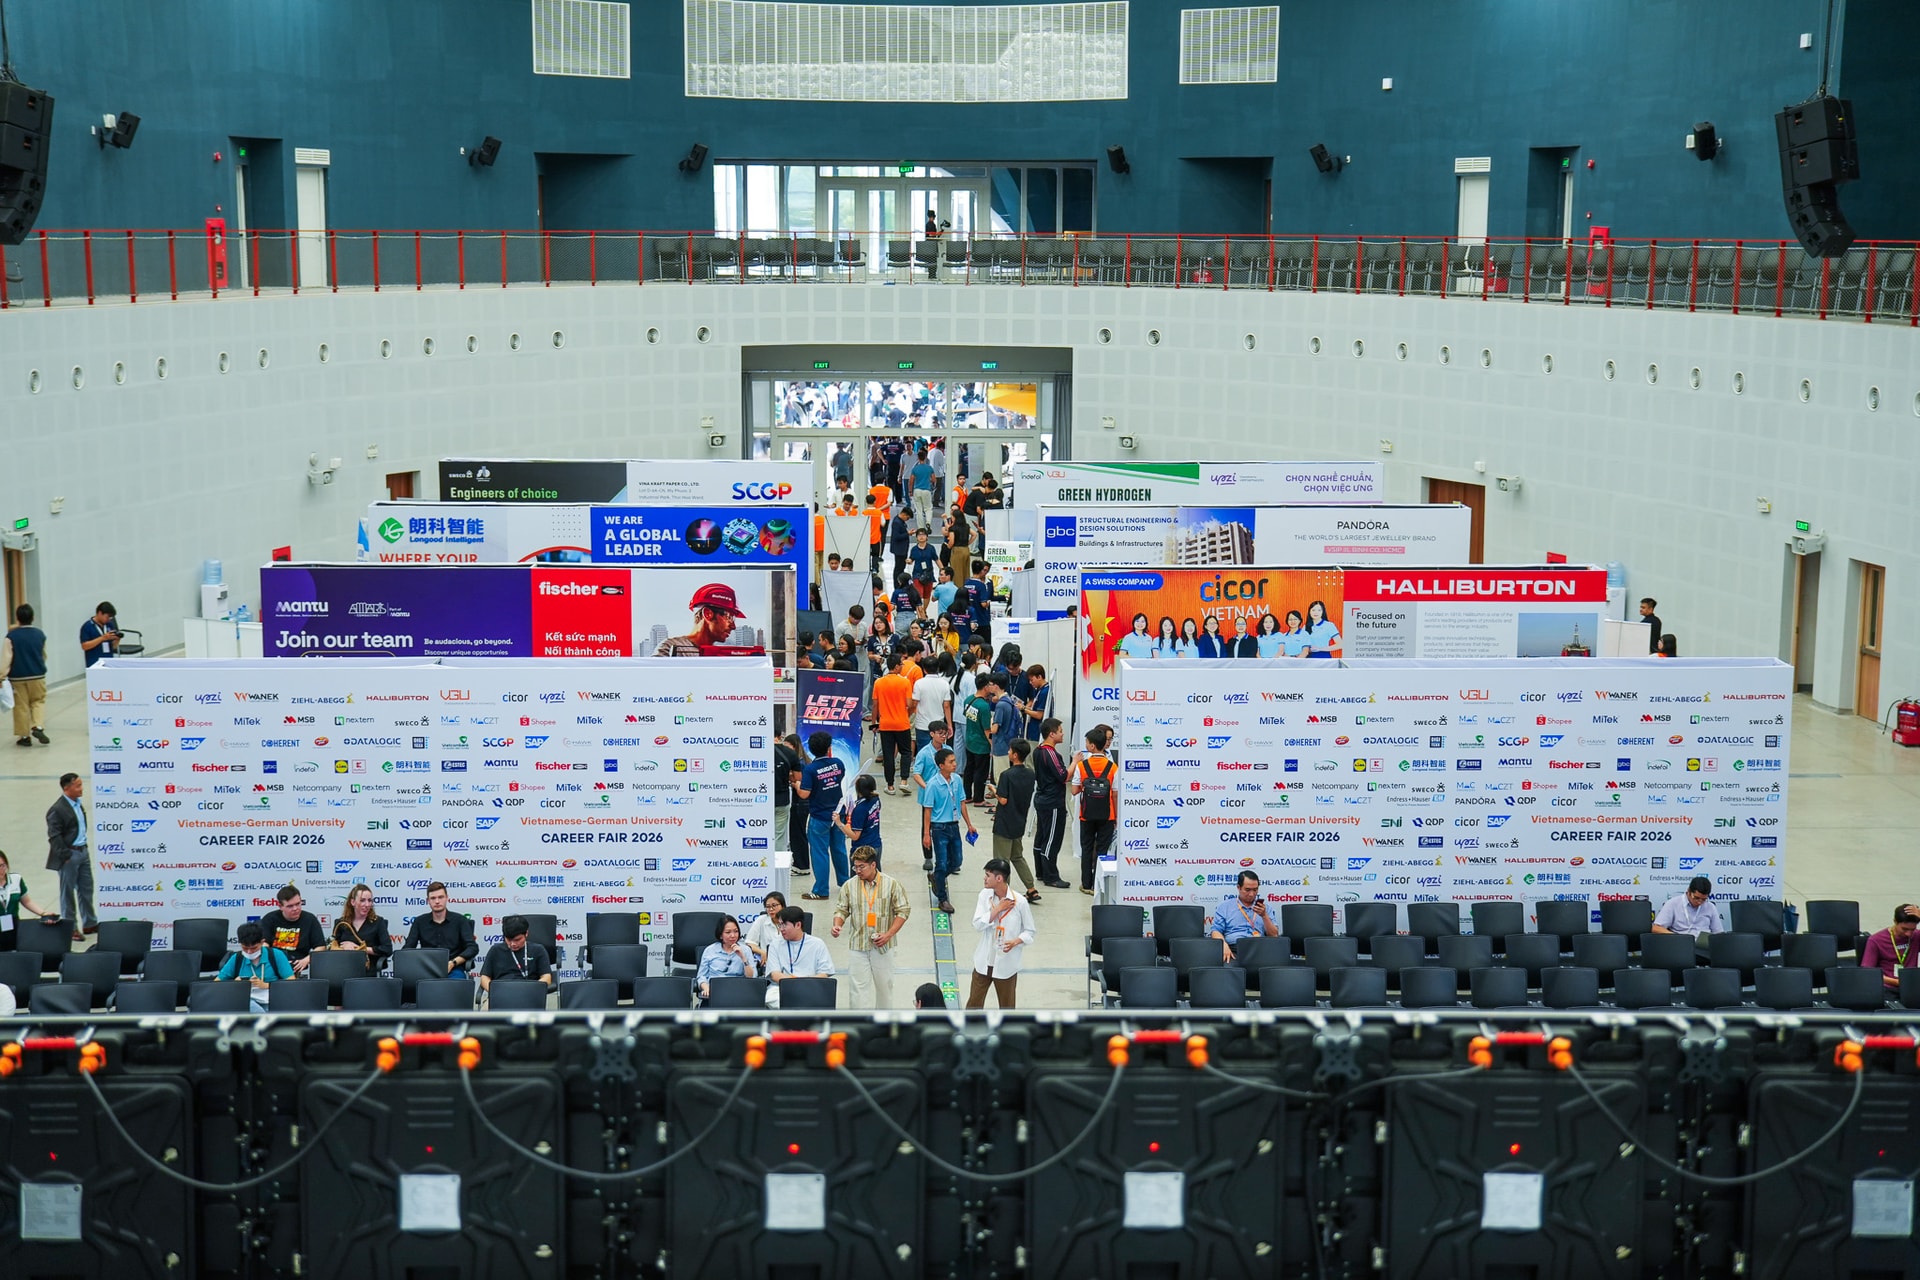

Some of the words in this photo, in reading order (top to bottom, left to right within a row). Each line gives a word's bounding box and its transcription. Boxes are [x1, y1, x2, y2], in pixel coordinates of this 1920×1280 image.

[1286, 475, 1311, 483] CHỌN
[1313, 471, 1337, 481] NGHỀ
[1340, 471, 1373, 482] CHUẨN,
[732, 483, 792, 500] SCGP
[1304, 485, 1329, 494] CHỌN
[1331, 483, 1351, 493] VIỆC
[449, 487, 505, 502] Engineers
[508, 488, 518, 498] of
[521, 488, 557, 498] choice
[1059, 489, 1091, 501] GREEN
[1096, 489, 1151, 501] HYDROGEN
[604, 516, 624, 525] WE
[623, 516, 643, 525] ARE
[409, 517, 484, 535] 朗科智能
[604, 529, 616, 540] A
[620, 529, 681, 541] GLOBAL
[1046, 526, 1075, 538] gbc
[410, 536, 443, 544] Longood
[445, 536, 484, 544] Intelligent
[606, 544, 662, 555] LEADER
[379, 553, 431, 564] WHERE
[987, 555, 1016, 563] HYDROGEN
[1045, 562, 1077, 570] GROW
[1084, 577, 1092, 585] A
[1092, 577, 1116, 586] SWISS
[1117, 577, 1155, 586] COMPANY
[539, 581, 599, 595] fischer
[1200, 574, 1269, 603] cicor
[1377, 579, 1576, 595] HALLIBURTON
[1357, 612, 1392, 620] Focused
[276, 631, 319, 648] Join
[324, 635, 358, 648] our
[361, 632, 413, 647] team
[484, 638, 513, 646] beyond.
[546, 632, 563, 641] Kết
[566, 632, 585, 641] sức
[588, 633, 616, 643] mạnh
[450, 649, 471, 657] unique
[545, 646, 561, 655] Nối
[564, 647, 592, 657] thành
[596, 647, 621, 658] công
[157, 693, 183, 703] cicor
[248, 692, 278, 702] WANEK
[291, 696, 344, 704] ZIEHL-ABEGG
[1607, 691, 1637, 700] WANEK
[805, 694, 859, 709] LET'S
[803, 706, 854, 720] ROCK
[185, 719, 212, 728] Shopee
[234, 717, 260, 725] MiTek
[298, 716, 315, 724] MSB
[346, 716, 374, 724] nextern
[137, 740, 169, 749] SCGP
[181, 737, 200, 749] SAP
[349, 737, 401, 745] DATALOGIC
[192, 763, 229, 772] fischer
[535, 761, 571, 771] fischer
[1549, 760, 1584, 769] fischer
[633, 783, 680, 792] Netcompany
[1237, 783, 1261, 792] MiTek
[178, 819, 288, 828] Vietnamese-German
[292, 818, 345, 828] University
[521, 817, 627, 827] Vietnamese-German
[631, 816, 683, 826] University
[1201, 816, 1305, 826] Vietnamese-German
[1309, 816, 1360, 826] University
[1531, 815, 1637, 825] Vietnamese-German
[1641, 815, 1693, 825] University
[200, 835, 253, 845] CAREER
[259, 835, 288, 845] FAIR
[293, 835, 325, 844] 2026
[542, 833, 593, 843] CAREER
[599, 833, 627, 842] FAIR
[632, 833, 663, 842] 2026
[1220, 832, 1271, 842] CAREER
[1277, 832, 1305, 842] FAIR
[1309, 832, 1340, 841] 2026
[1551, 831, 1603, 841] CAREER
[1608, 831, 1636, 841] FAIR
[1641, 831, 1672, 841] 2026
